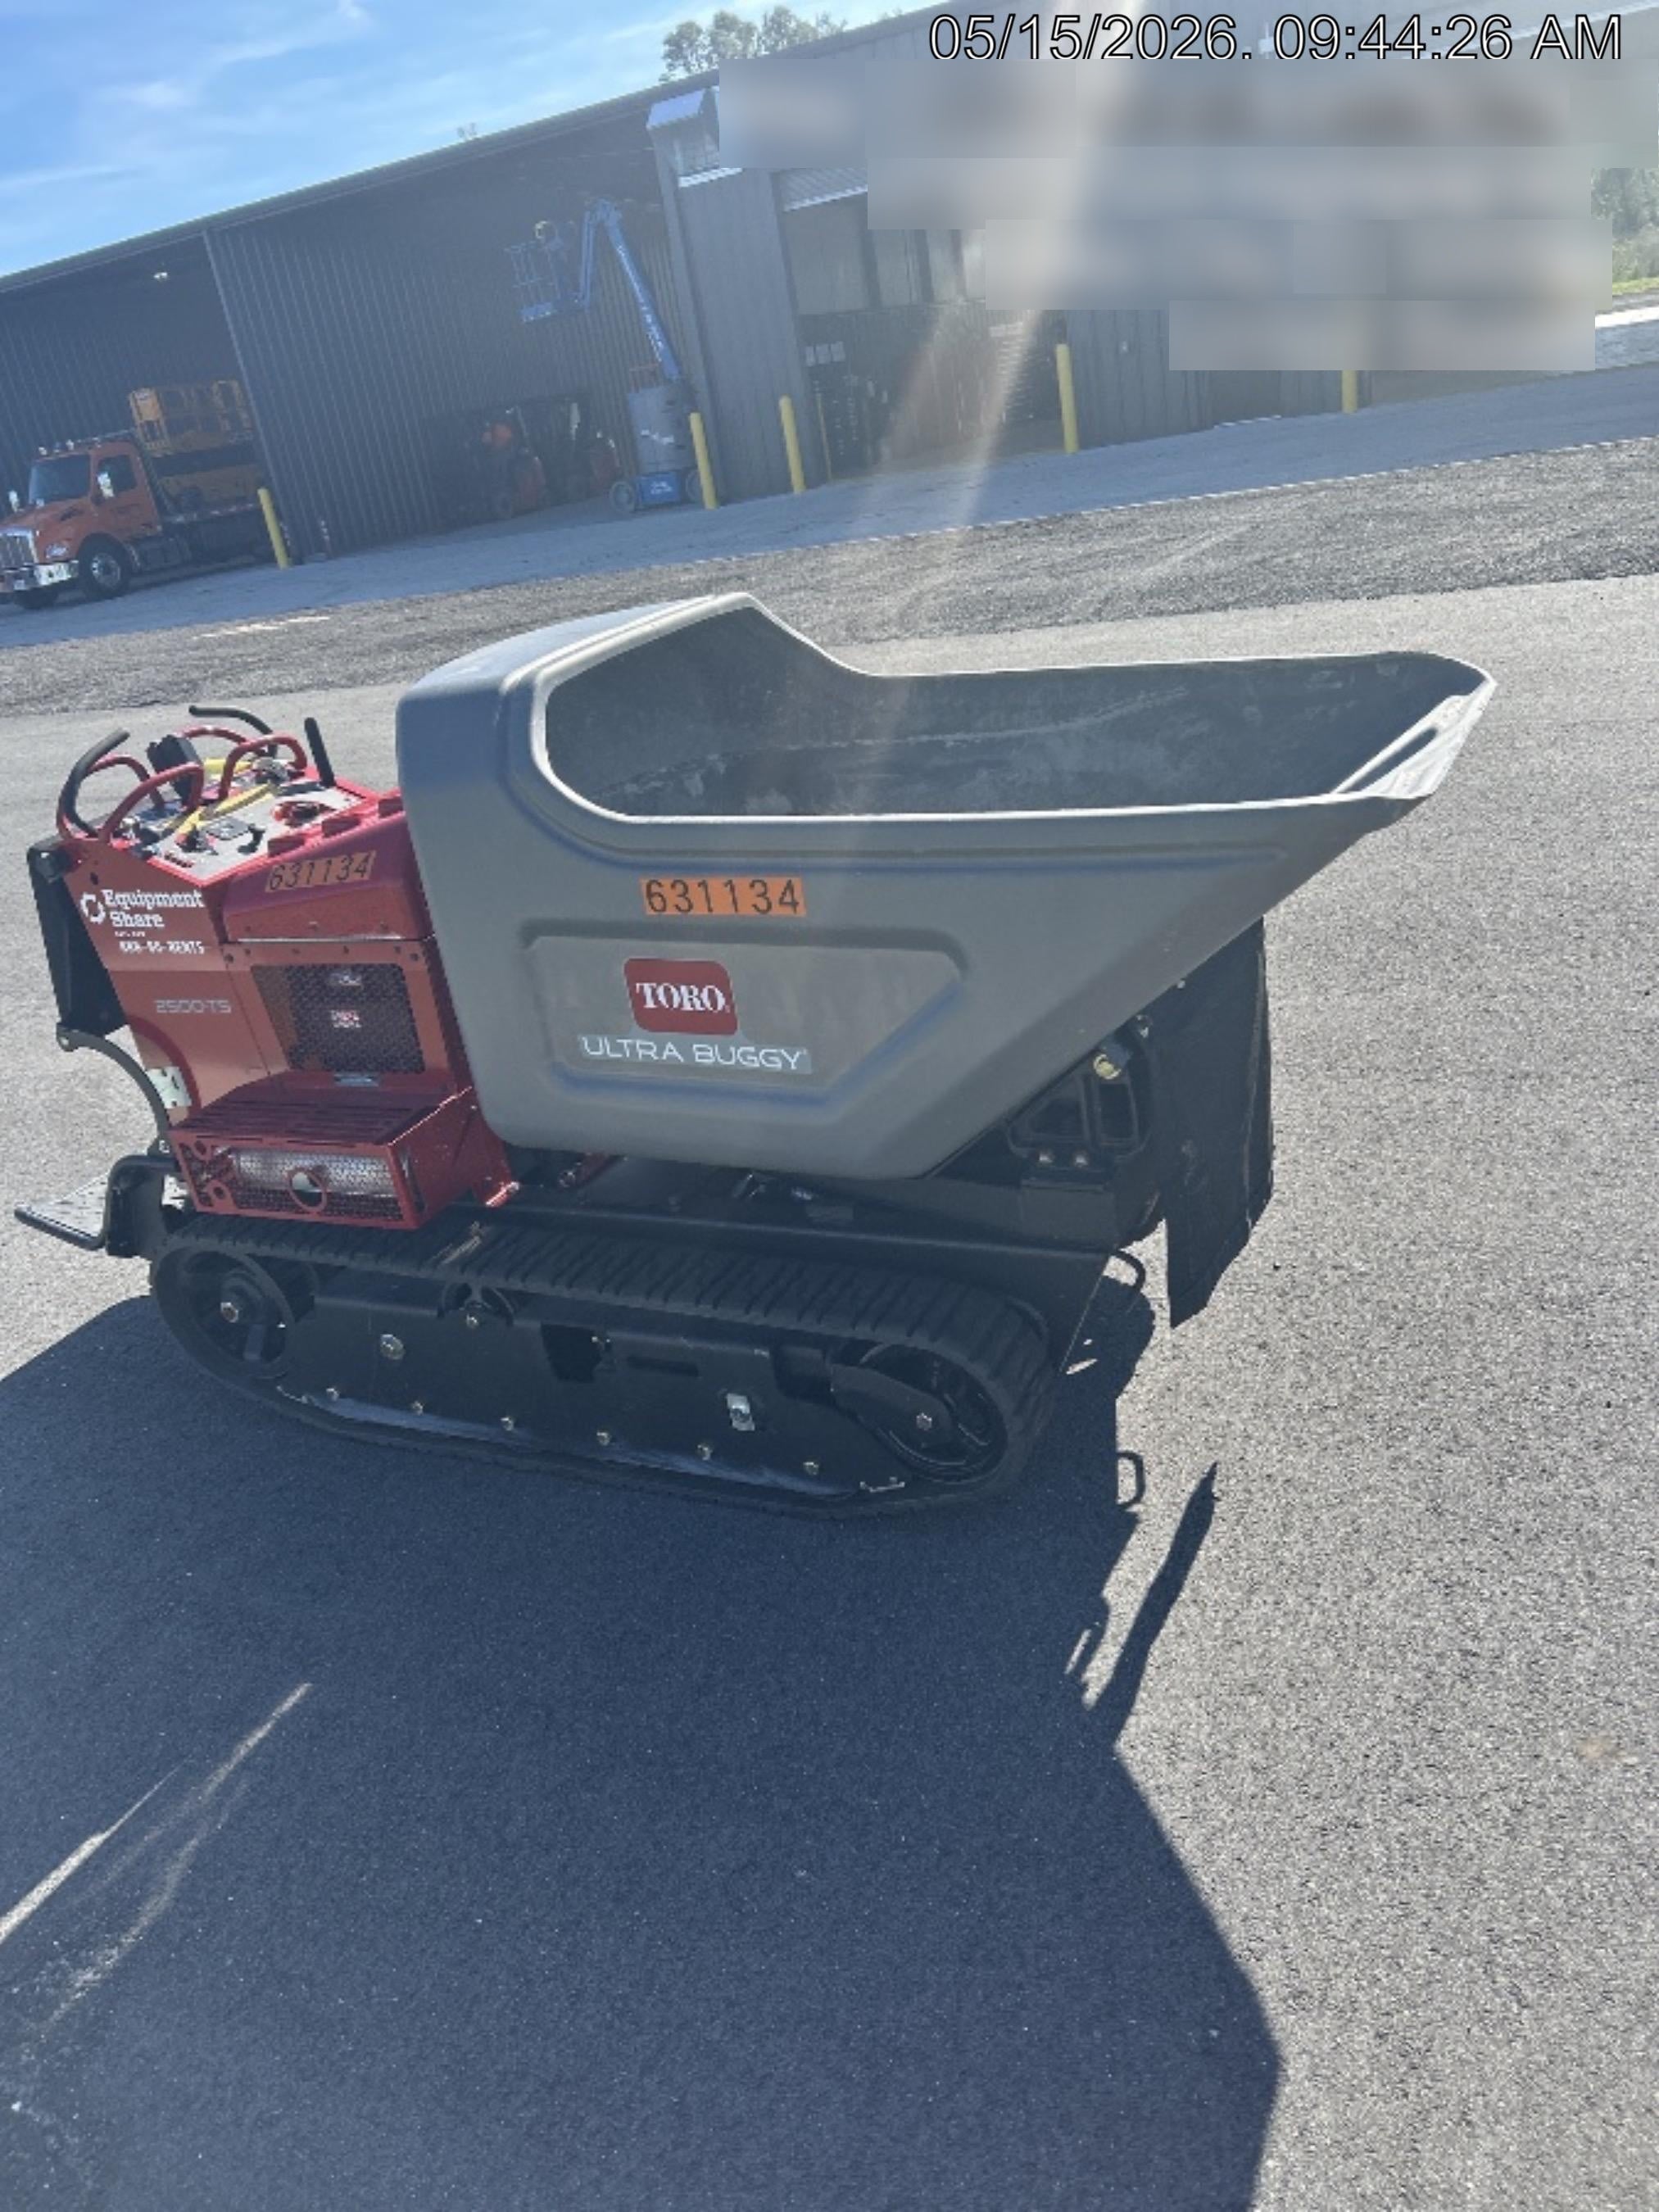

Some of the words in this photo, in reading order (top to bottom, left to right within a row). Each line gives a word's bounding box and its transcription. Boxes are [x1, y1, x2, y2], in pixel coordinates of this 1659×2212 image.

[269, 852, 372, 891] 631134
[101, 889, 206, 910] Equipment
[645, 878, 800, 914] 631134
[109, 910, 165, 928] Share
[635, 982, 726, 1013] TORO
[581, 1036, 685, 1063] ULTRA
[691, 1043, 802, 1071] BUGGY
